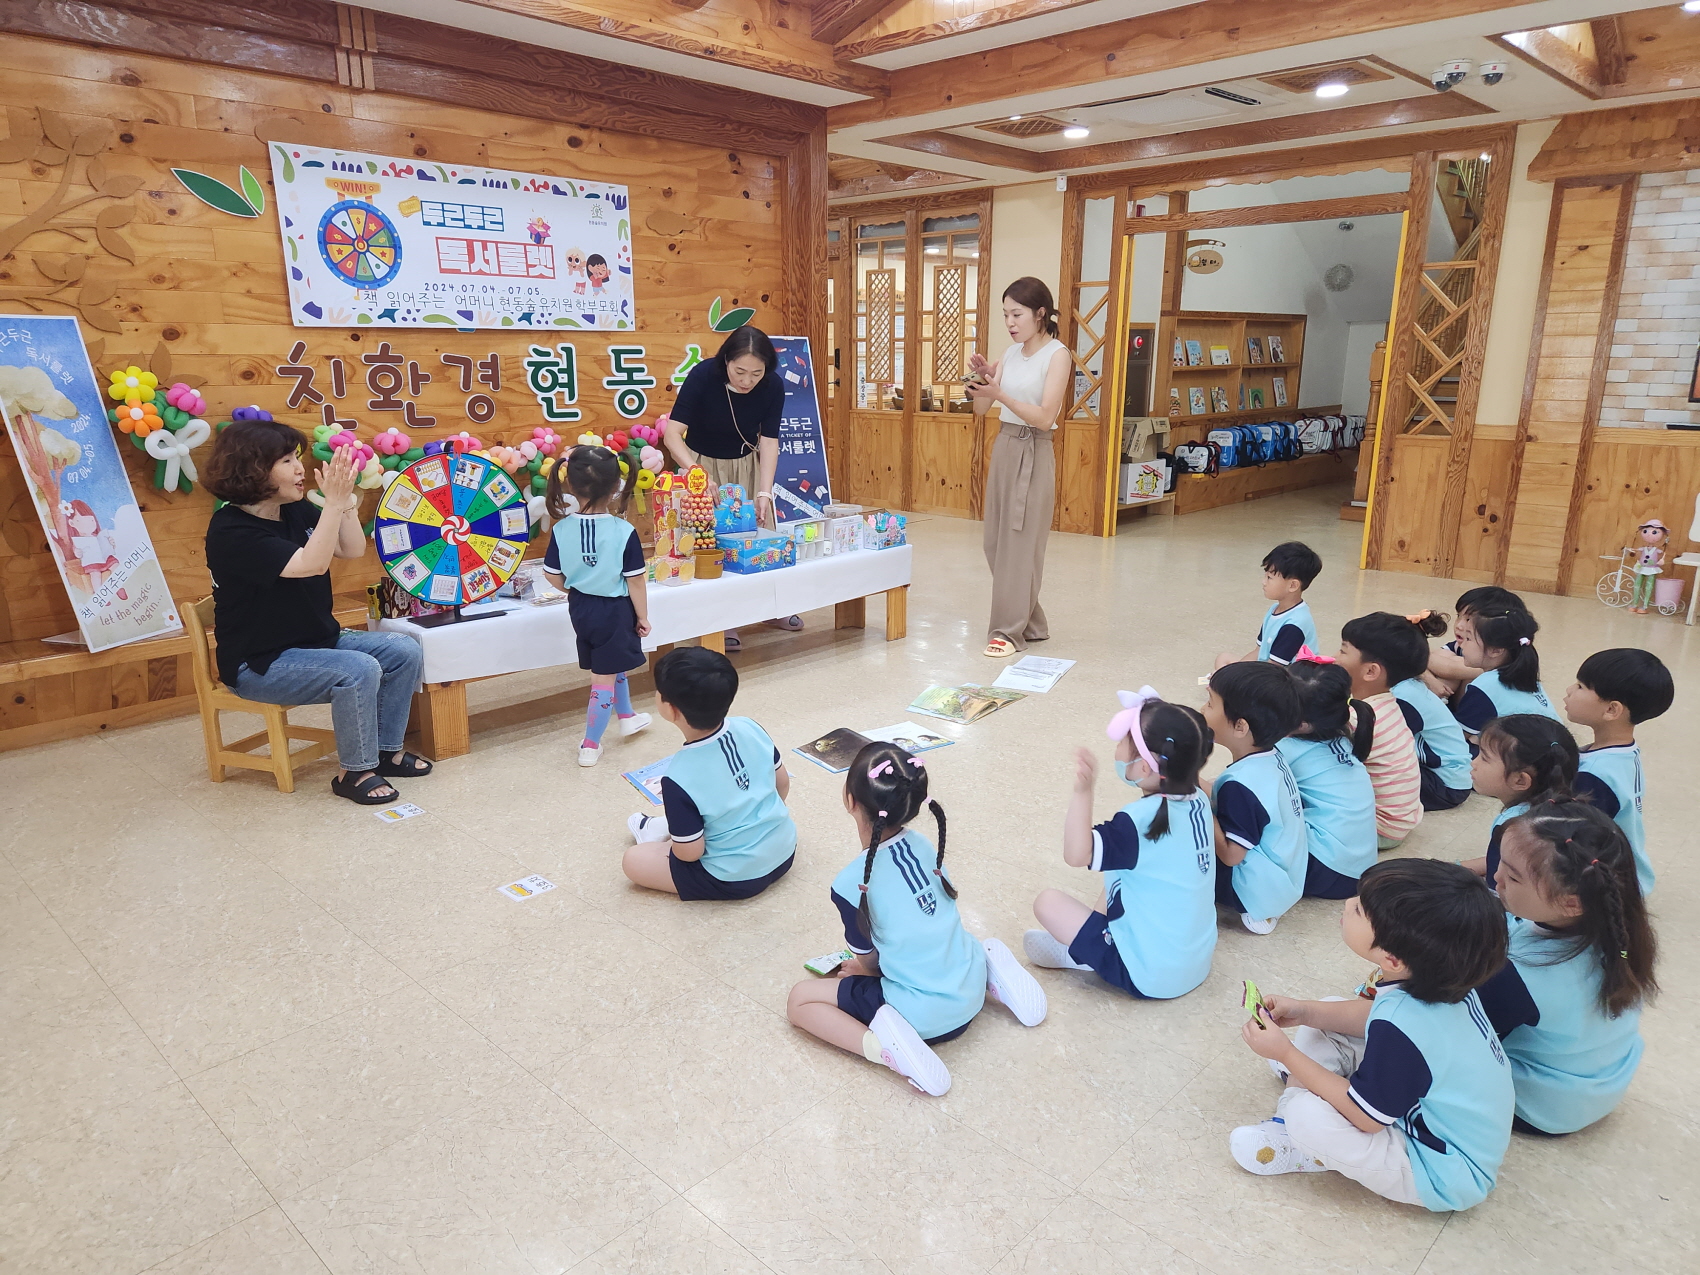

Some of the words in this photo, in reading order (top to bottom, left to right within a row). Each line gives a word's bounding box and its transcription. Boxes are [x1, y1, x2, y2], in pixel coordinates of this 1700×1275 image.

[340, 181, 367, 194] WIN!
[421, 200, 504, 232] 두근두근
[435, 236, 556, 279] 독서룰렛
[364, 290, 378, 307] 책
[386, 292, 446, 308] 읽어주는
[454, 294, 494, 310] 어머니
[0, 328, 33, 352] 근두근
[276, 340, 500, 430] 친환경
[522, 342, 702, 422] 현동
[778, 440, 816, 454] 서룰렛
[80, 606, 96, 618] 책
[92, 570, 128, 608] 읽어주는
[124, 542, 152, 569] 어머니
[468, 571, 492, 593] SUPER!
[100, 614, 115, 626] let
[115, 608, 132, 620] the
[130, 582, 152, 610] magic
